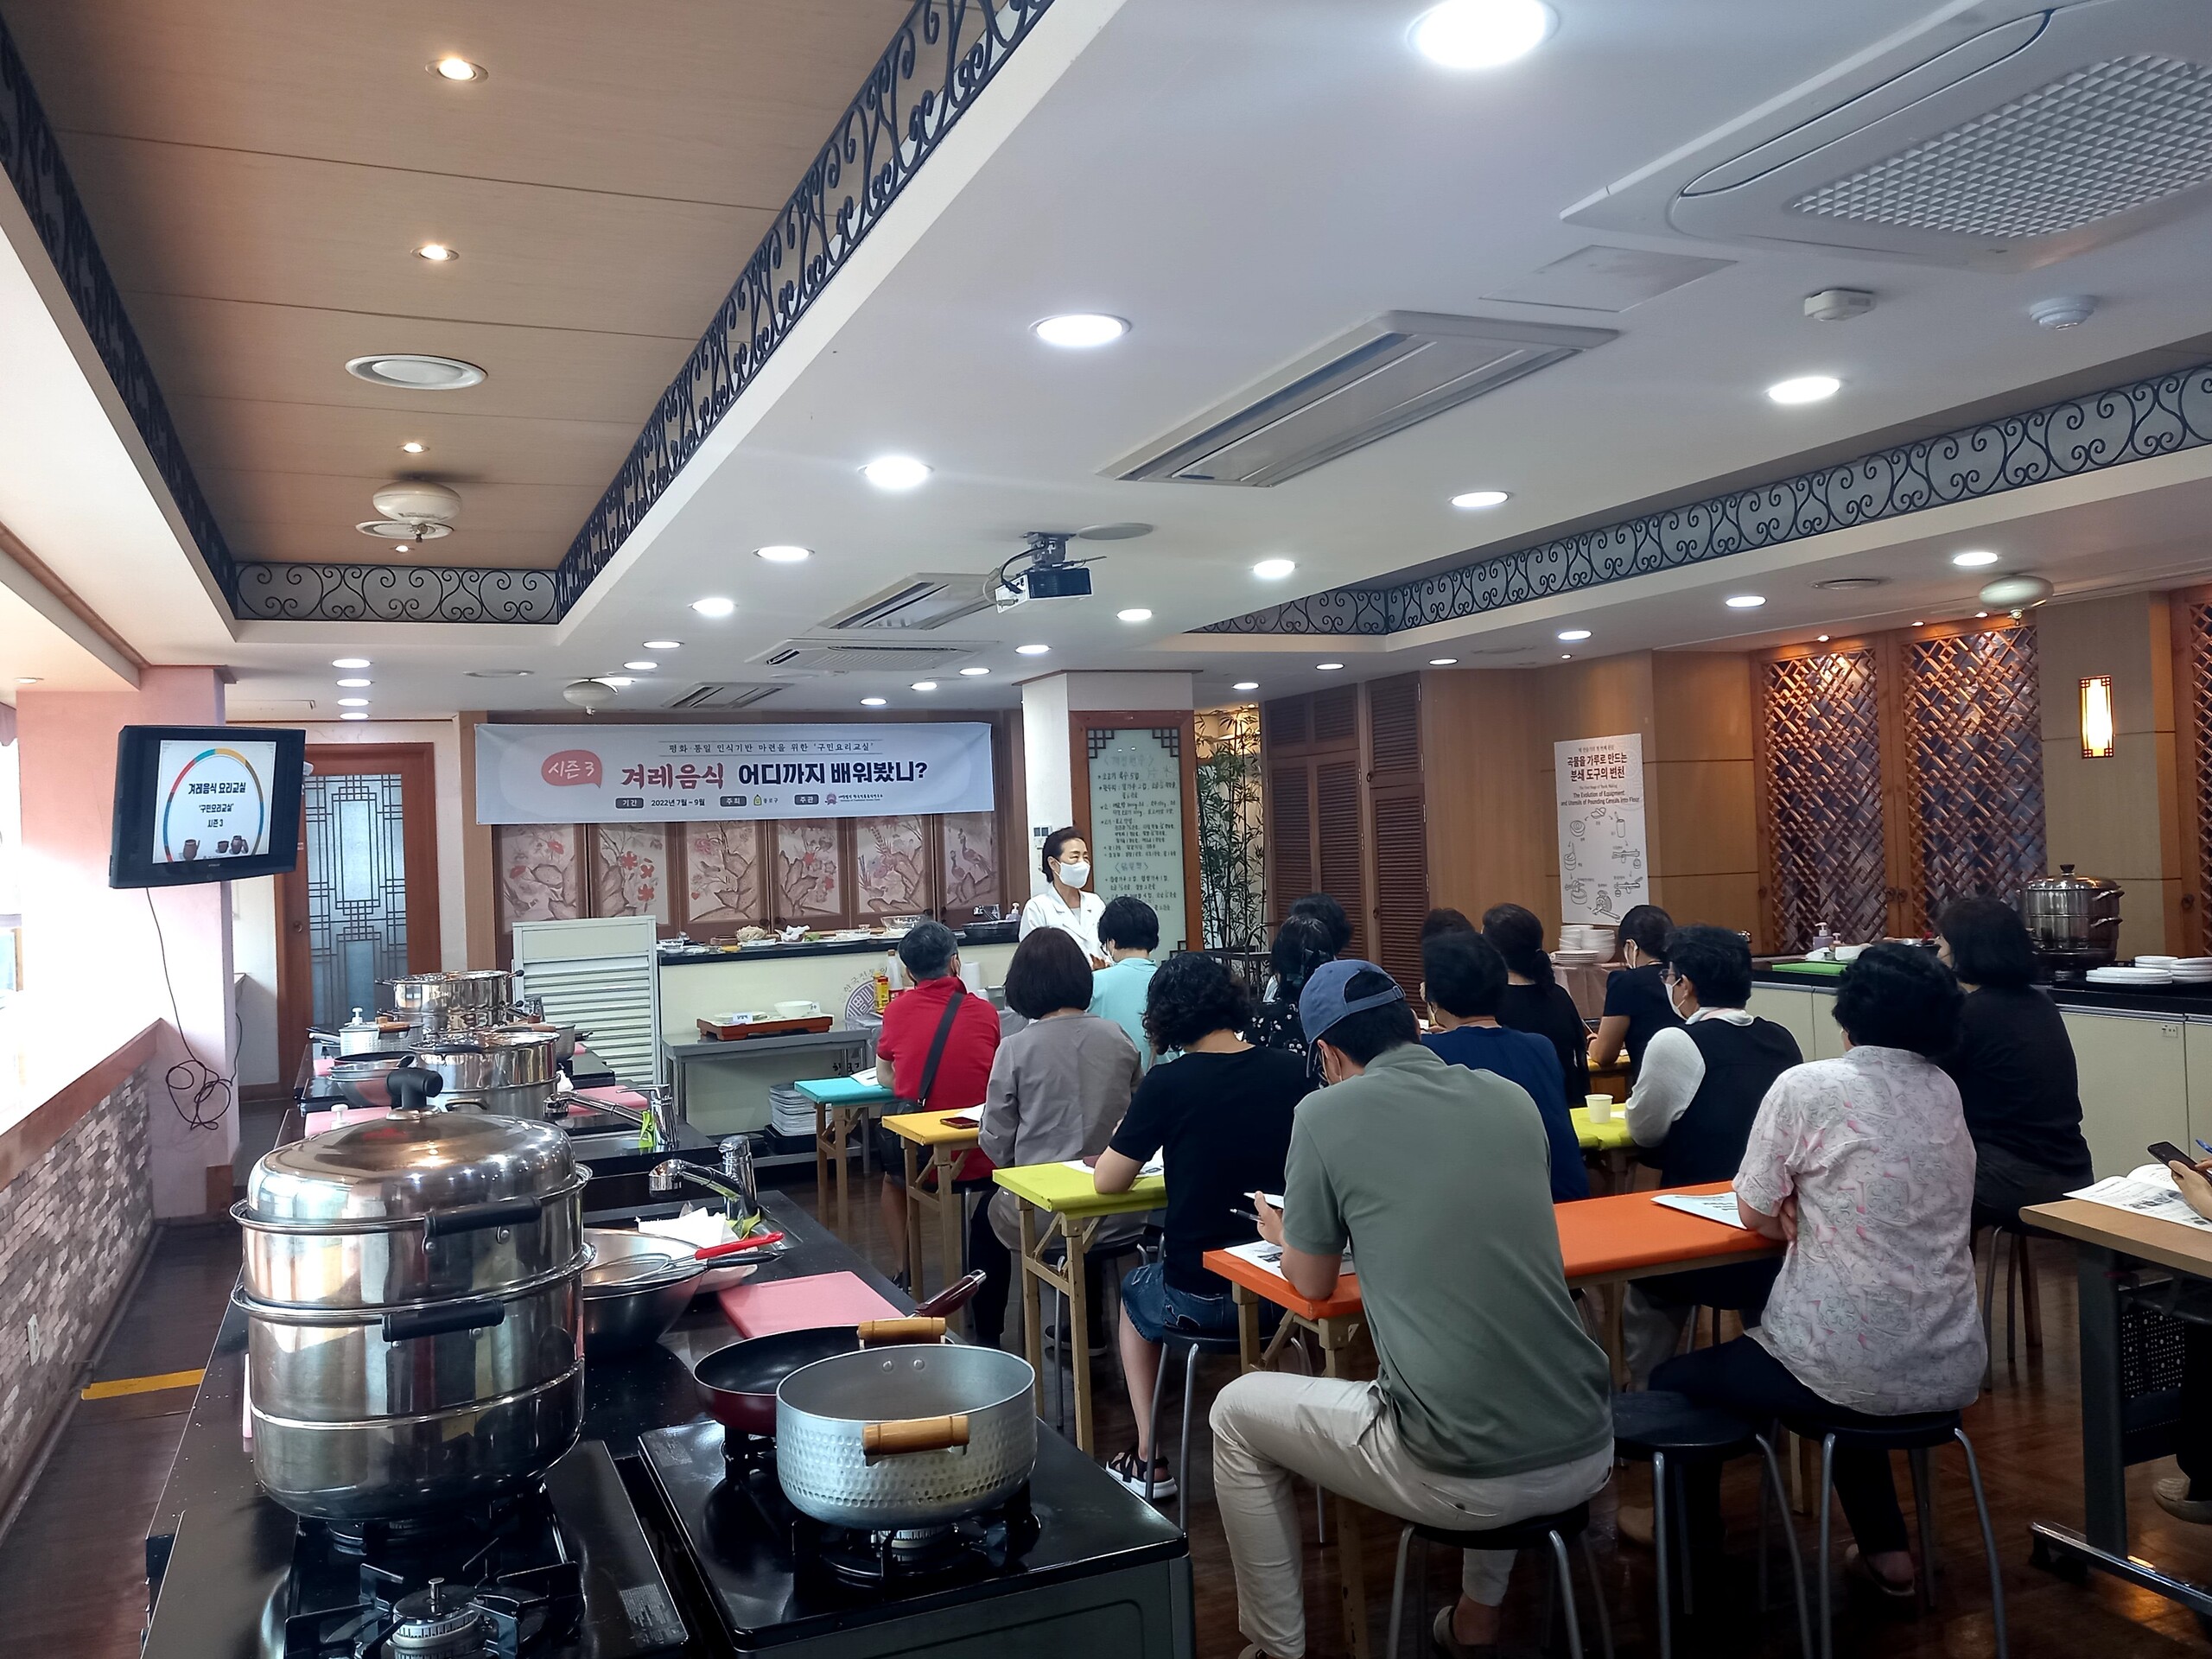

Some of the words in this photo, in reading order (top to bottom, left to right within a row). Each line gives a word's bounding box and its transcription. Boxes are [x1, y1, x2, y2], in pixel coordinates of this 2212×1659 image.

[716, 743, 753, 753] 인식기반
[759, 743, 785, 753] 마련을
[791, 743, 809, 753] 위한
[1567, 755, 1586, 768] 곡물을
[1586, 753, 1607, 766] 가루로
[1608, 752, 1628, 765] 만드는
[548, 760, 581, 779] 시즌
[584, 761, 595, 777] 3
[620, 763, 724, 790] 겨레음식
[739, 763, 825, 785] 어디까지
[830, 761, 928, 784] 배워봤니?
[1571, 769, 1585, 782] 분쇄
[1586, 767, 1608, 780] 도구의
[1610, 766, 1625, 779] 변천
[188, 783, 218, 795] 겨레음식
[219, 782, 246, 794] 요리교실
[207, 818, 219, 828] 시즌
[219, 818, 224, 828] 3
